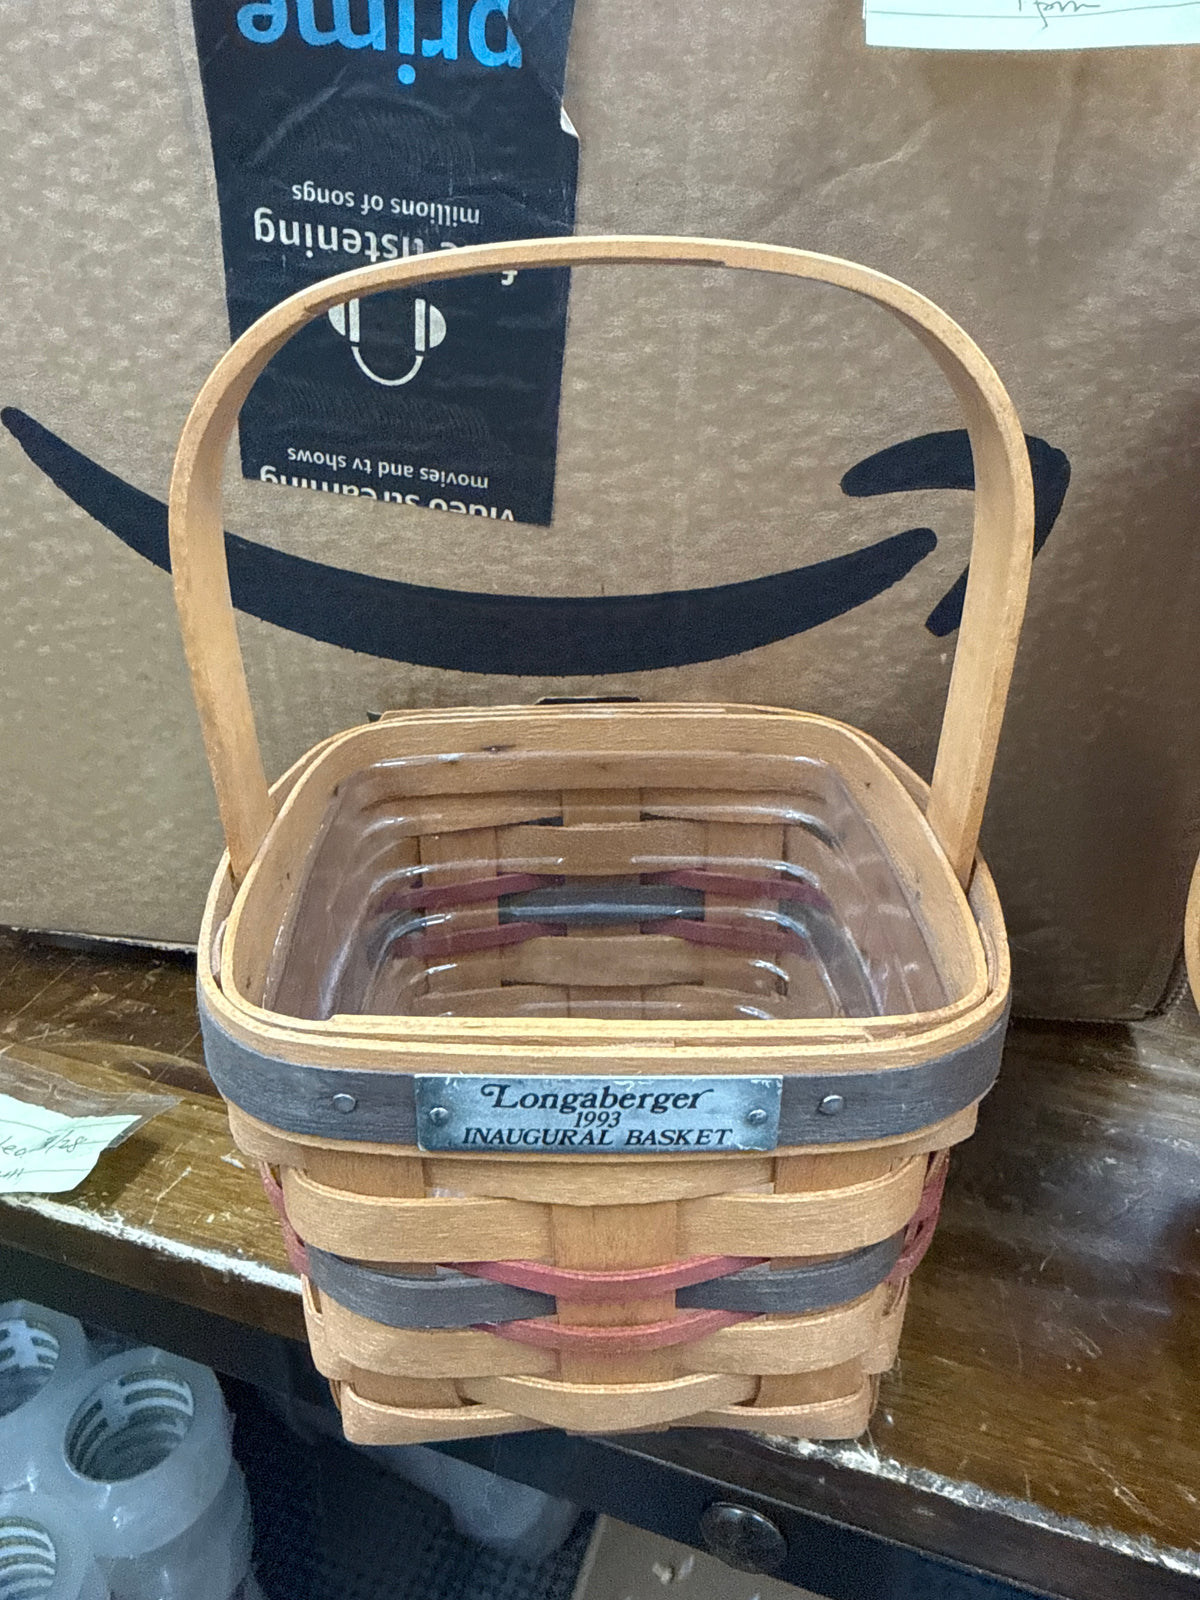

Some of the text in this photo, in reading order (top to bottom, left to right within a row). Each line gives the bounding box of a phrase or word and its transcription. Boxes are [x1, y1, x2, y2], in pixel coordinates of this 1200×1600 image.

[236, 0, 523, 85] prime
[291, 180, 480, 225] millions of songs
[287, 447, 489, 490] movies and tv shows
[480, 1083, 714, 1114] Longaberger
[462, 1127, 733, 1146] INAUGURAL BASKET
[573, 1111, 622, 1129] 1993
